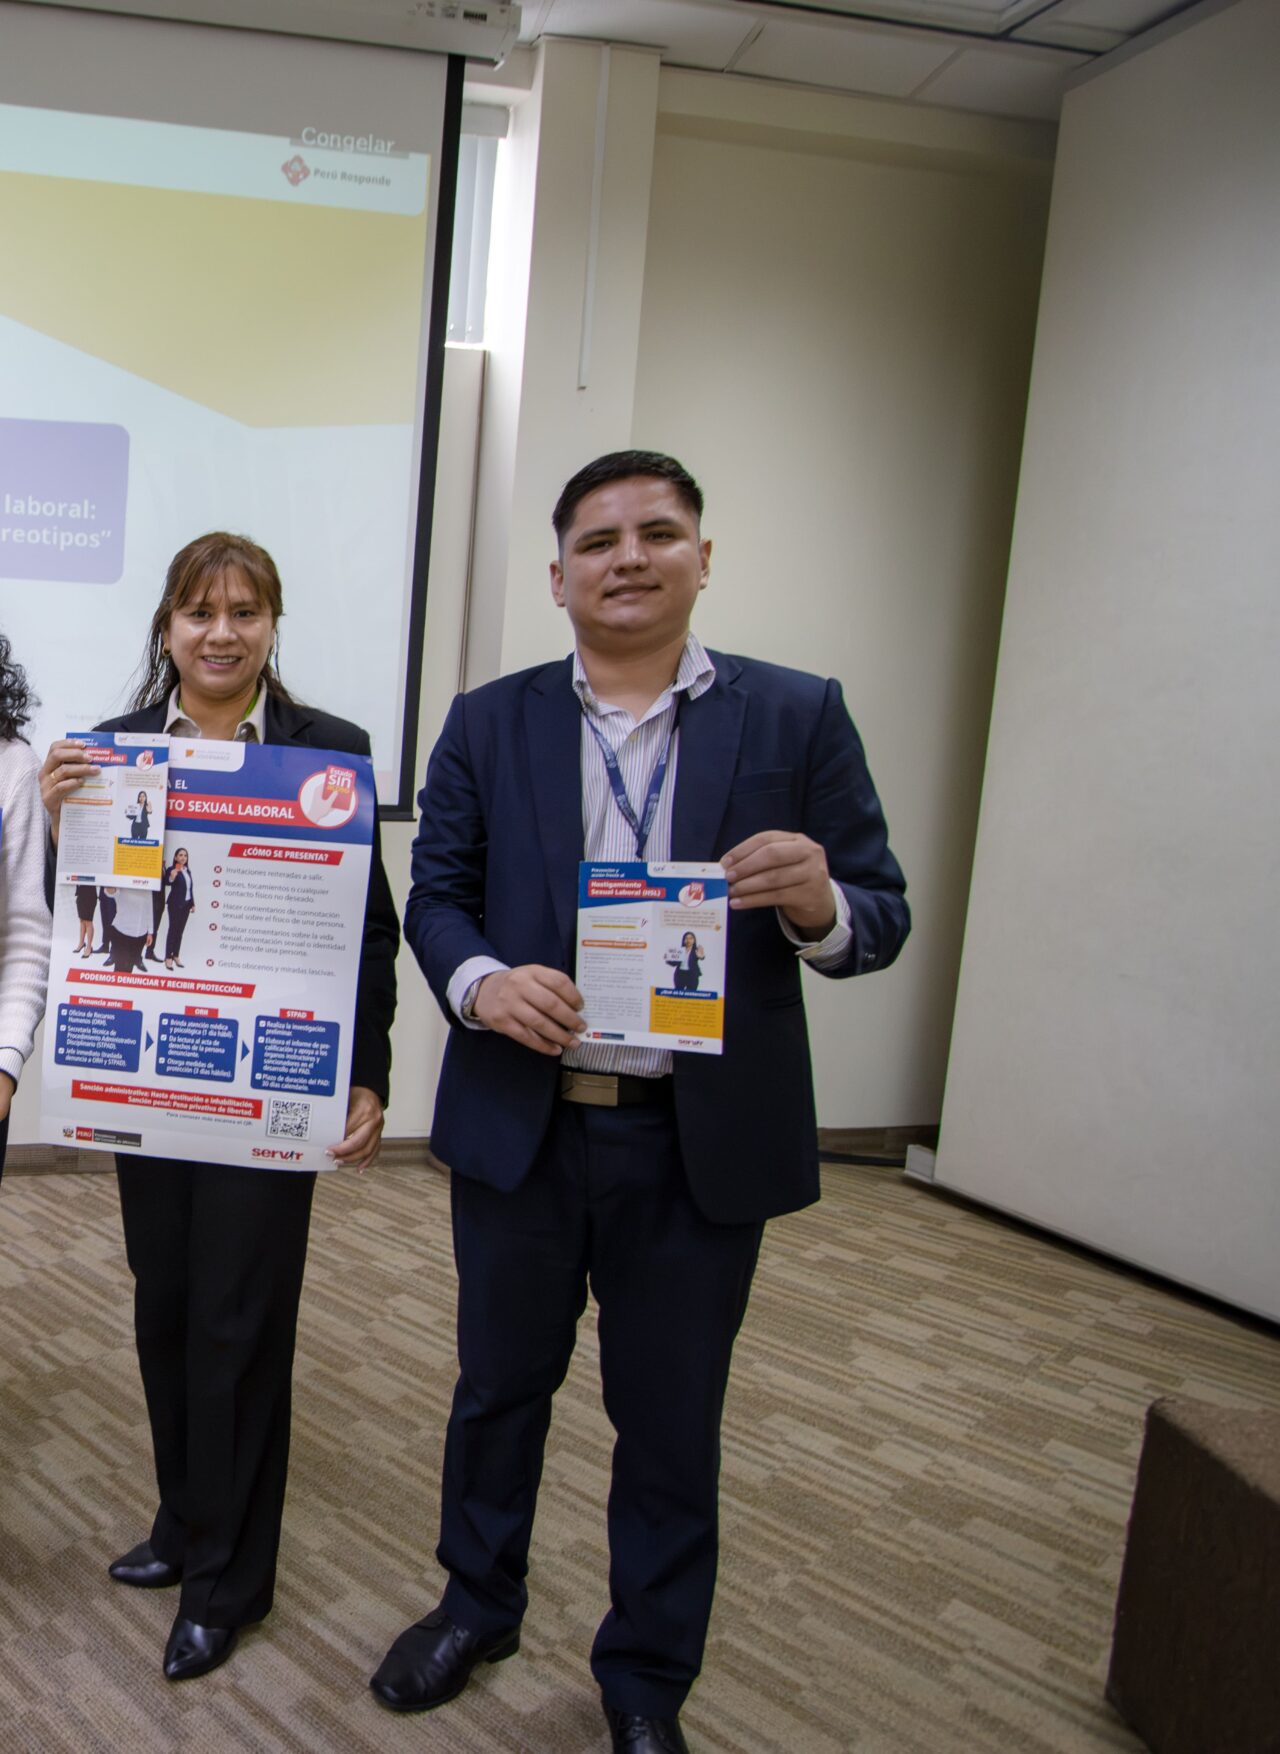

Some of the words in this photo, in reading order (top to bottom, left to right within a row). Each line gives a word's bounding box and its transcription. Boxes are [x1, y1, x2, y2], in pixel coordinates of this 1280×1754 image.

[301, 126, 396, 154] Congelar
[340, 172, 391, 186] Responde
[4, 494, 96, 520] laboral:
[330, 768, 352, 778] Estado
[175, 780, 188, 790] EL
[328, 774, 351, 788] sin
[188, 800, 234, 814] SEXUAL
[238, 804, 294, 818] LABORAL
[243, 847, 271, 856] ¿CÓMO
[285, 850, 328, 861] PRESENTA?
[80, 973, 115, 982] PODEMOS
[118, 976, 158, 986] DENUNCIAR
[161, 979, 165, 987] Y
[167, 980, 194, 989] RECIBIR
[196, 982, 242, 994] PROTECCIÓN
[252, 1148, 303, 1160] servir
